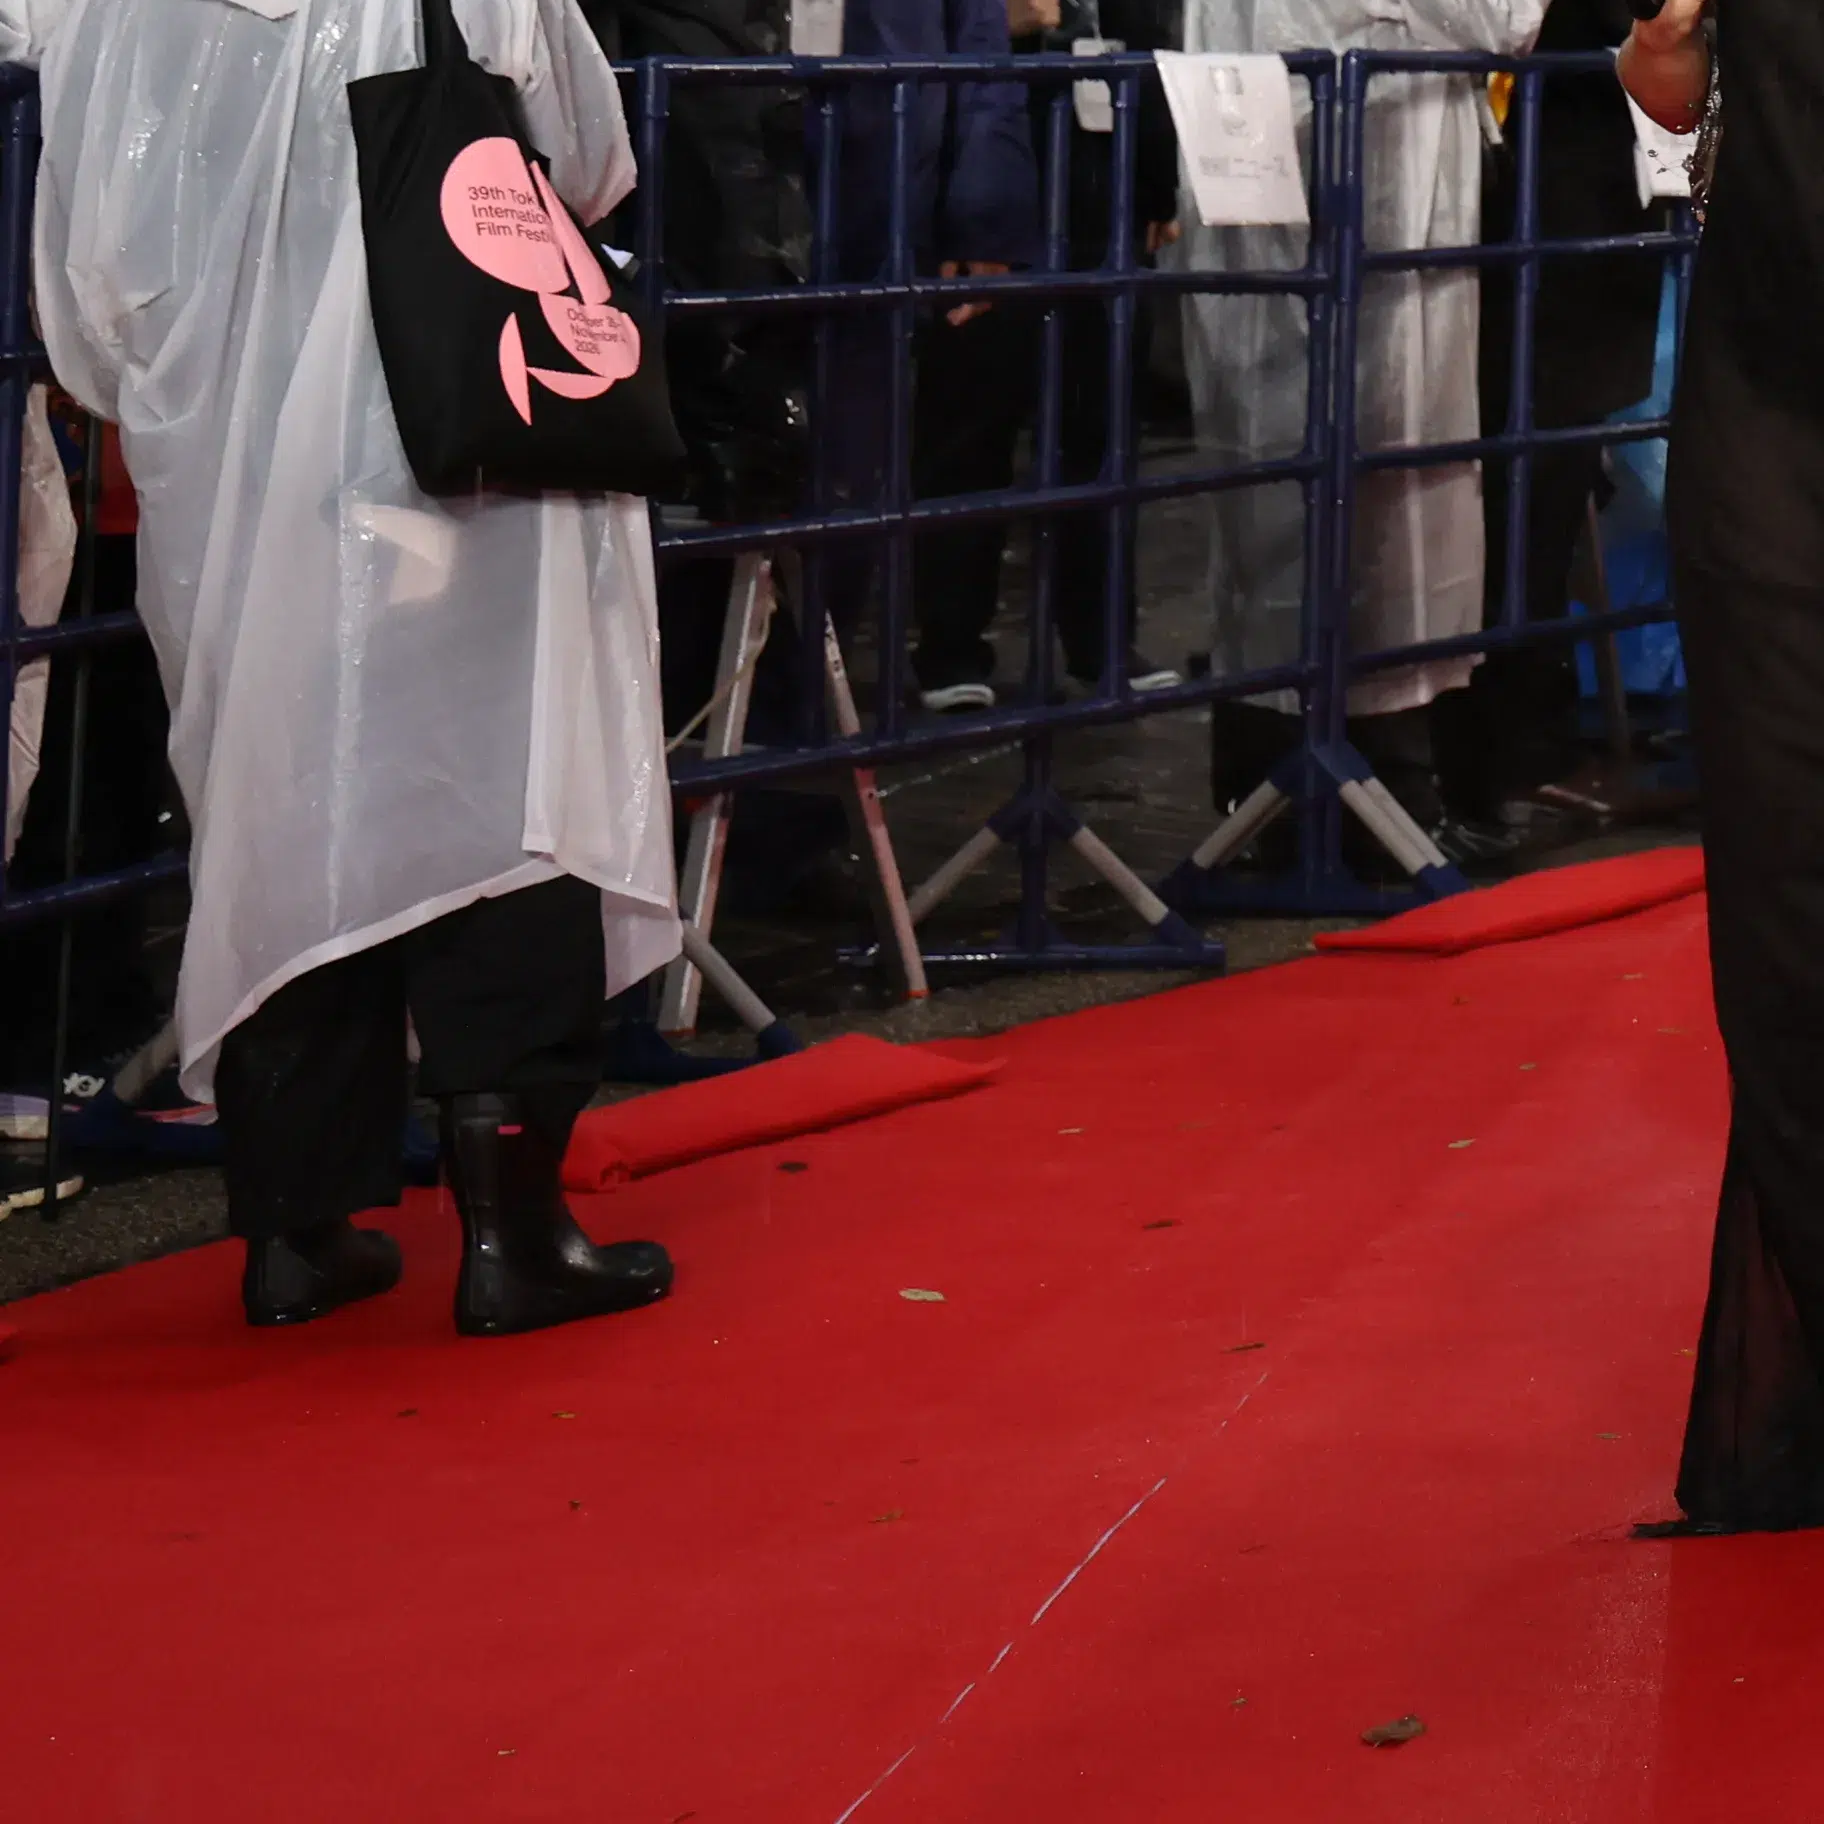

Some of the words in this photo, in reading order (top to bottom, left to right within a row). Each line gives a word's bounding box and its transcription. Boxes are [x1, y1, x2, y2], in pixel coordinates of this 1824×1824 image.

[468, 186, 506, 202] 39th
[508, 188, 536, 205] Tok
[472, 204, 554, 225] Internatio
[476, 221, 512, 237] Film
